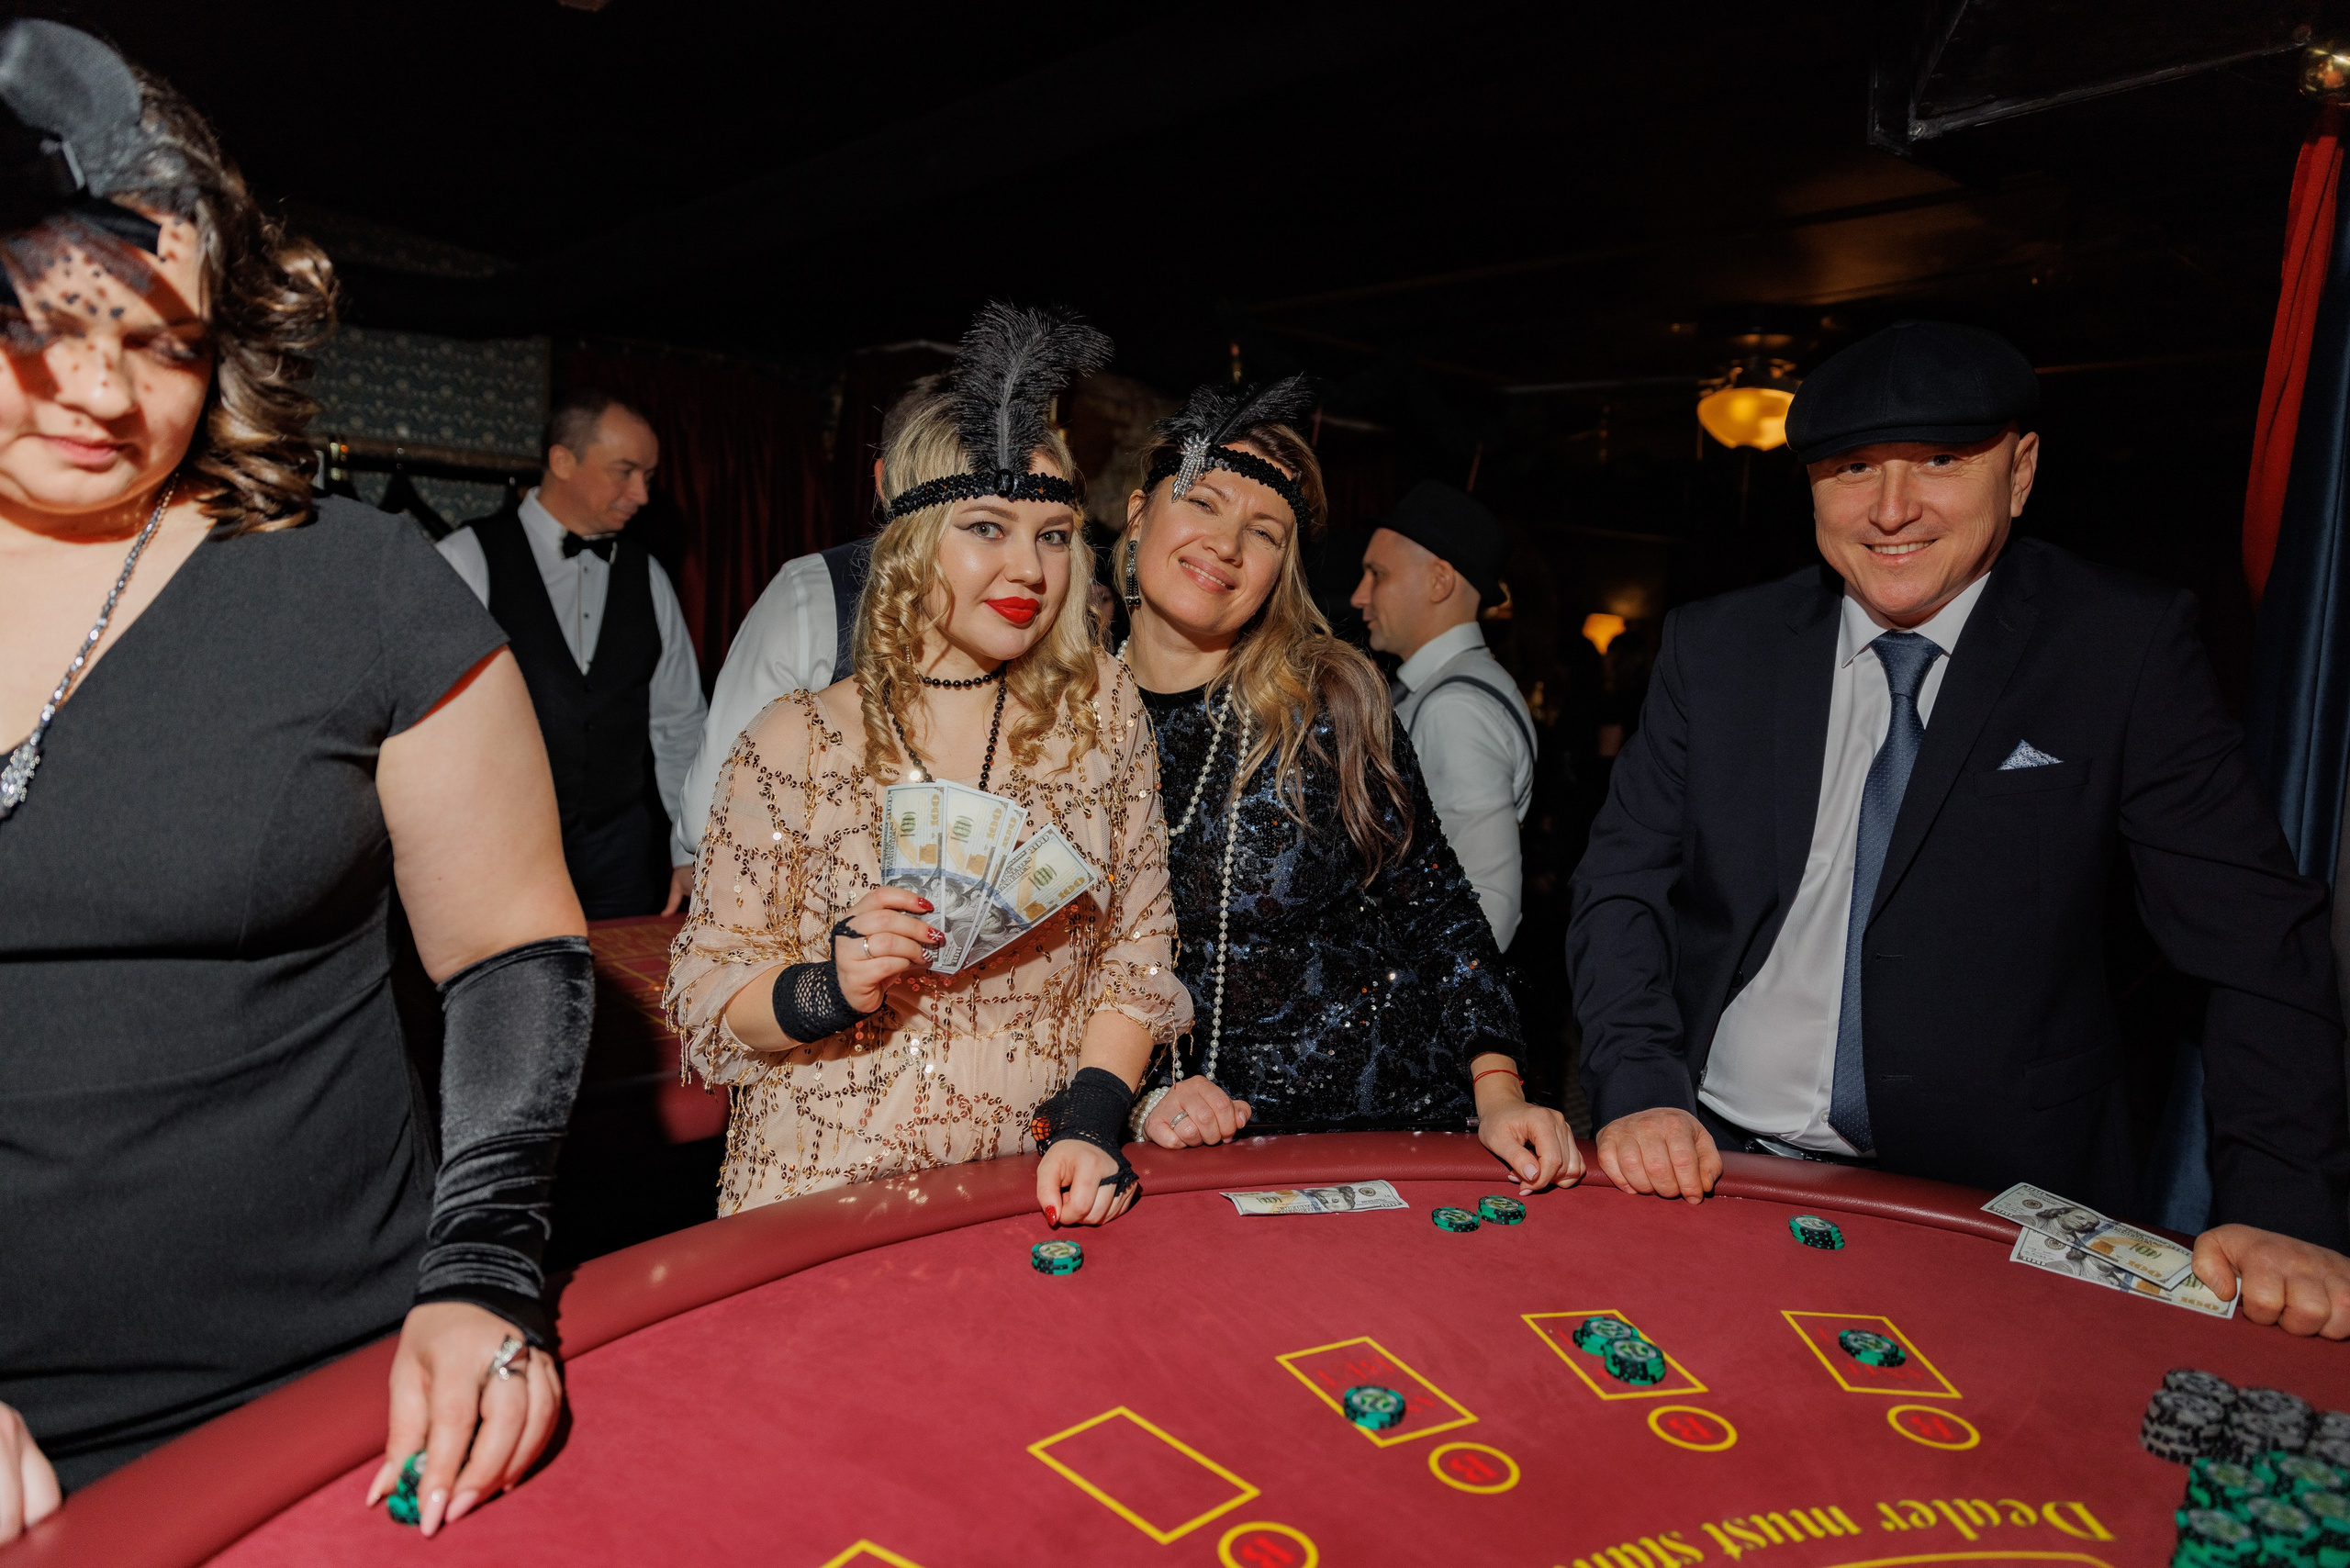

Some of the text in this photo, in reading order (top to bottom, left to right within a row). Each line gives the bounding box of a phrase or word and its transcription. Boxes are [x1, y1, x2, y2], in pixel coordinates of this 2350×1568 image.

[930, 793, 940, 826] 100
[899, 812, 917, 837] 100
[950, 815, 974, 844] 100
[986, 807, 1002, 840] 100
[1028, 834, 1050, 855] 100
[1028, 863, 1058, 890] 100
[1058, 876, 1085, 900] 100
[2127, 1260, 2163, 1278] 100
[2180, 1295, 2220, 1311] 100
[1701, 1505, 1862, 1558] must
[1877, 1498, 2114, 1542] Dealer
